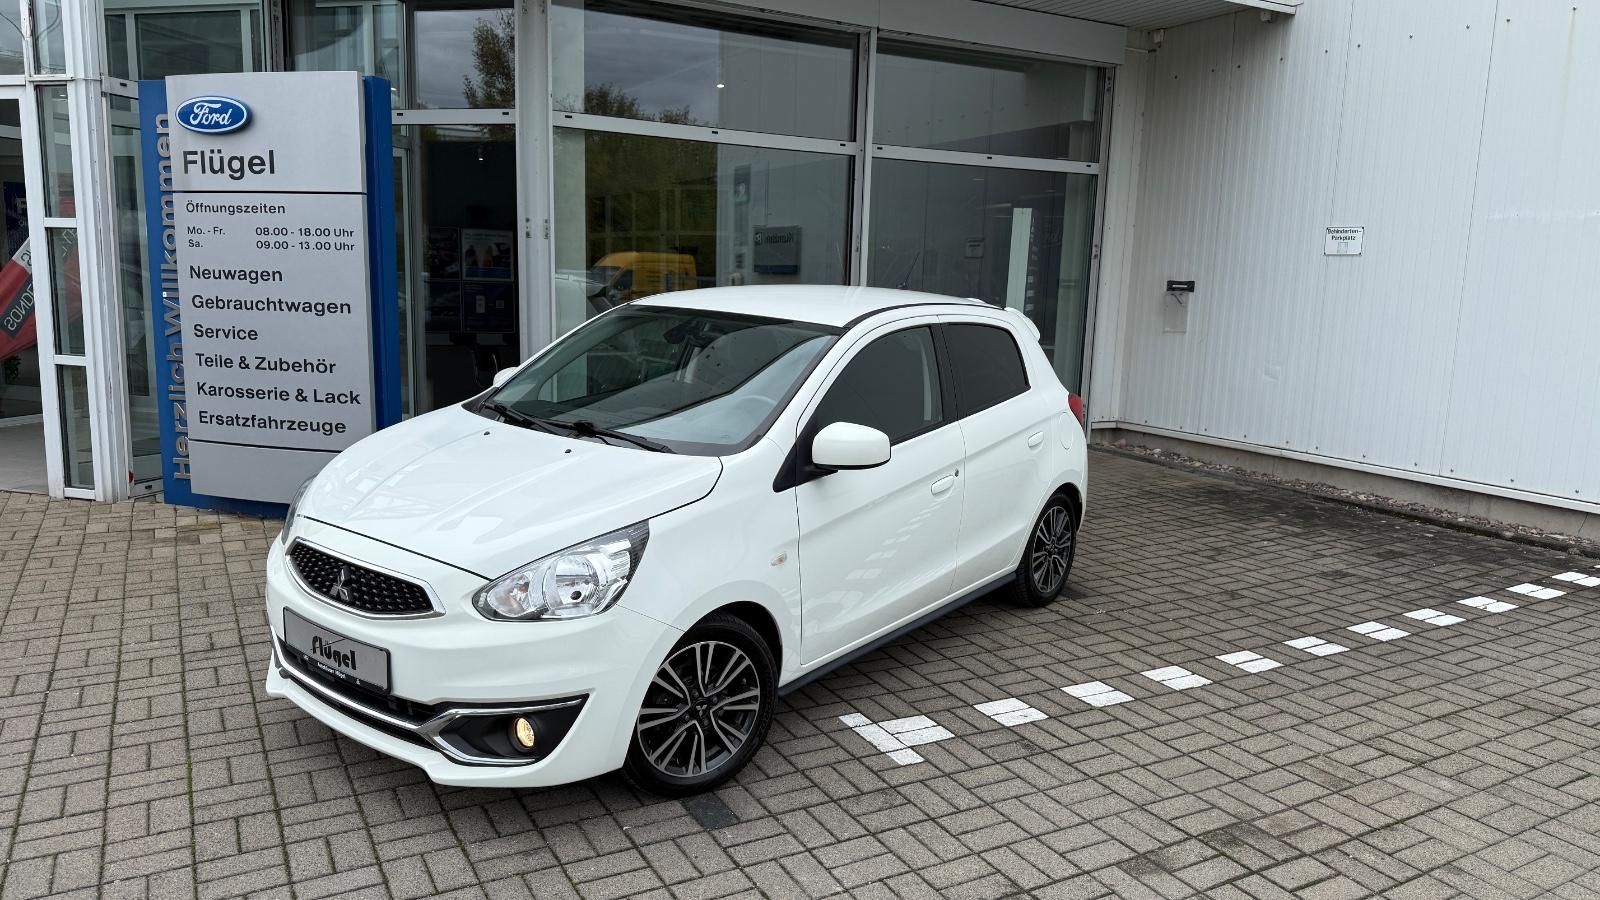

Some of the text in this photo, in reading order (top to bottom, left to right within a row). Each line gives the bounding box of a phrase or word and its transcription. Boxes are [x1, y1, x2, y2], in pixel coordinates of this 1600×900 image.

[189, 102, 232, 126] Ford
[182, 149, 276, 181] Flügel
[185, 200, 286, 216] Öffnungszeiten
[187, 226, 206, 235] Mo.
[213, 226, 226, 235] Fr.
[255, 227, 289, 237] 08.00
[298, 227, 331, 237] 18.00
[333, 228, 354, 238] Uhr
[188, 239, 204, 248] Sa.
[256, 240, 289, 250] 09.00
[298, 241, 331, 251] 13.00
[334, 241, 355, 251] Uhr
[189, 265, 283, 284] Neuwagen
[155, 113, 191, 480] Herzlich Willkommen
[191, 294, 352, 316] Gebrauchtwagen
[193, 323, 259, 341] Service
[195, 353, 337, 374] Teile & Zubehör
[196, 382, 362, 405] Karosserie & Lack
[198, 411, 347, 436] Ersatzfahrzeuge
